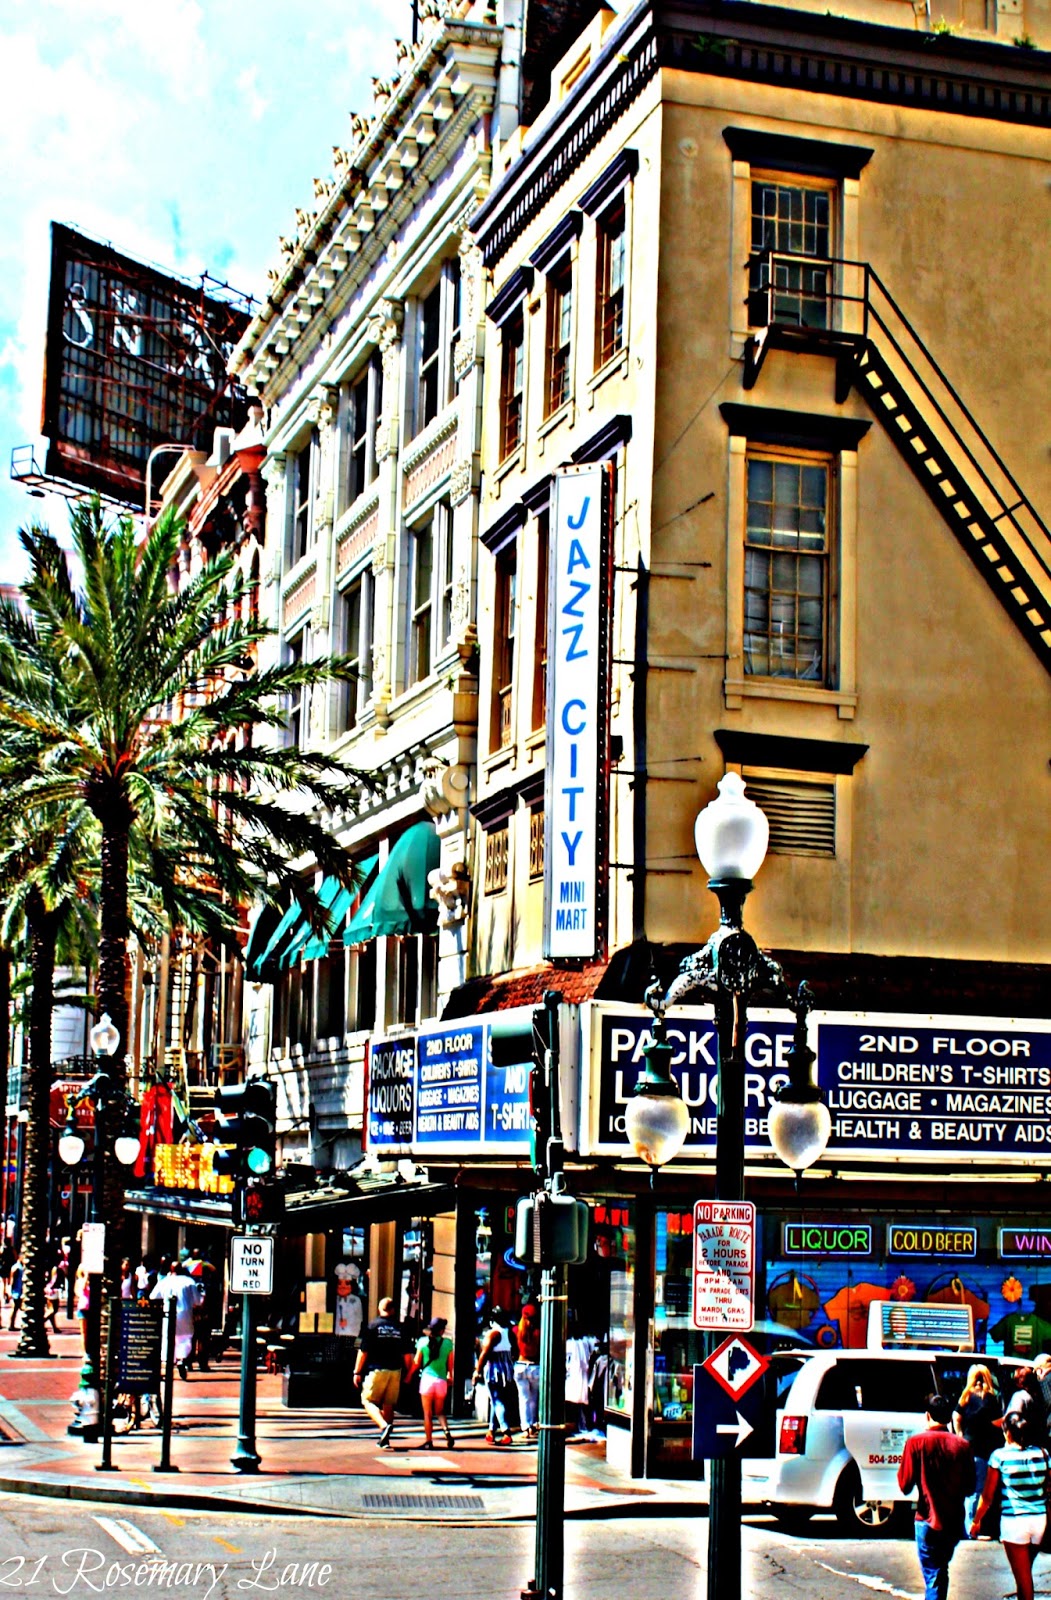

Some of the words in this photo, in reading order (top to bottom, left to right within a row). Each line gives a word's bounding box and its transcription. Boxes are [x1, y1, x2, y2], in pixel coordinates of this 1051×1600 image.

[562, 496, 591, 662] JAZZ
[561, 699, 587, 866] CITY
[560, 881, 585, 903] MINI
[556, 909, 587, 931] MART
[426, 1038, 442, 1056] 2ND
[445, 1033, 473, 1053] FLOOR
[611, 1028, 795, 1068] PACKGE
[859, 1035, 919, 1053] 2ND
[933, 1037, 1030, 1057] FLOOR
[372, 1049, 414, 1080] PACKAGE
[837, 1061, 953, 1084] CHILDREN'S
[961, 1065, 1051, 1087] T-SHIRTS
[504, 1065, 526, 1094] AND
[372, 1083, 412, 1113] LIQUORS
[828, 1090, 921, 1111] LUGGAGE
[946, 1094, 1051, 1115] MAGAZINES
[745, 1118, 769, 1136] BE
[830, 1119, 900, 1139] HEALTH
[909, 1121, 922, 1139] &
[931, 1122, 1006, 1141] BEAUTY
[697, 1205, 711, 1220] NO
[714, 1207, 750, 1220] PARKING
[698, 1226, 724, 1243] PARADE
[729, 1226, 751, 1244] ROUTE
[790, 1229, 868, 1250] LIQUOR
[893, 1231, 932, 1251] COLD
[936, 1232, 972, 1251] BEER
[243, 1244, 262, 1255] NO
[702, 1248, 708, 1258] 2
[714, 1249, 747, 1259] HOURS
[240, 1257, 264, 1266] TURN
[699, 1259, 721, 1267] BEFORE
[726, 1260, 749, 1268] PARADE
[717, 1268, 731, 1277] AND
[243, 1280, 260, 1288] RED
